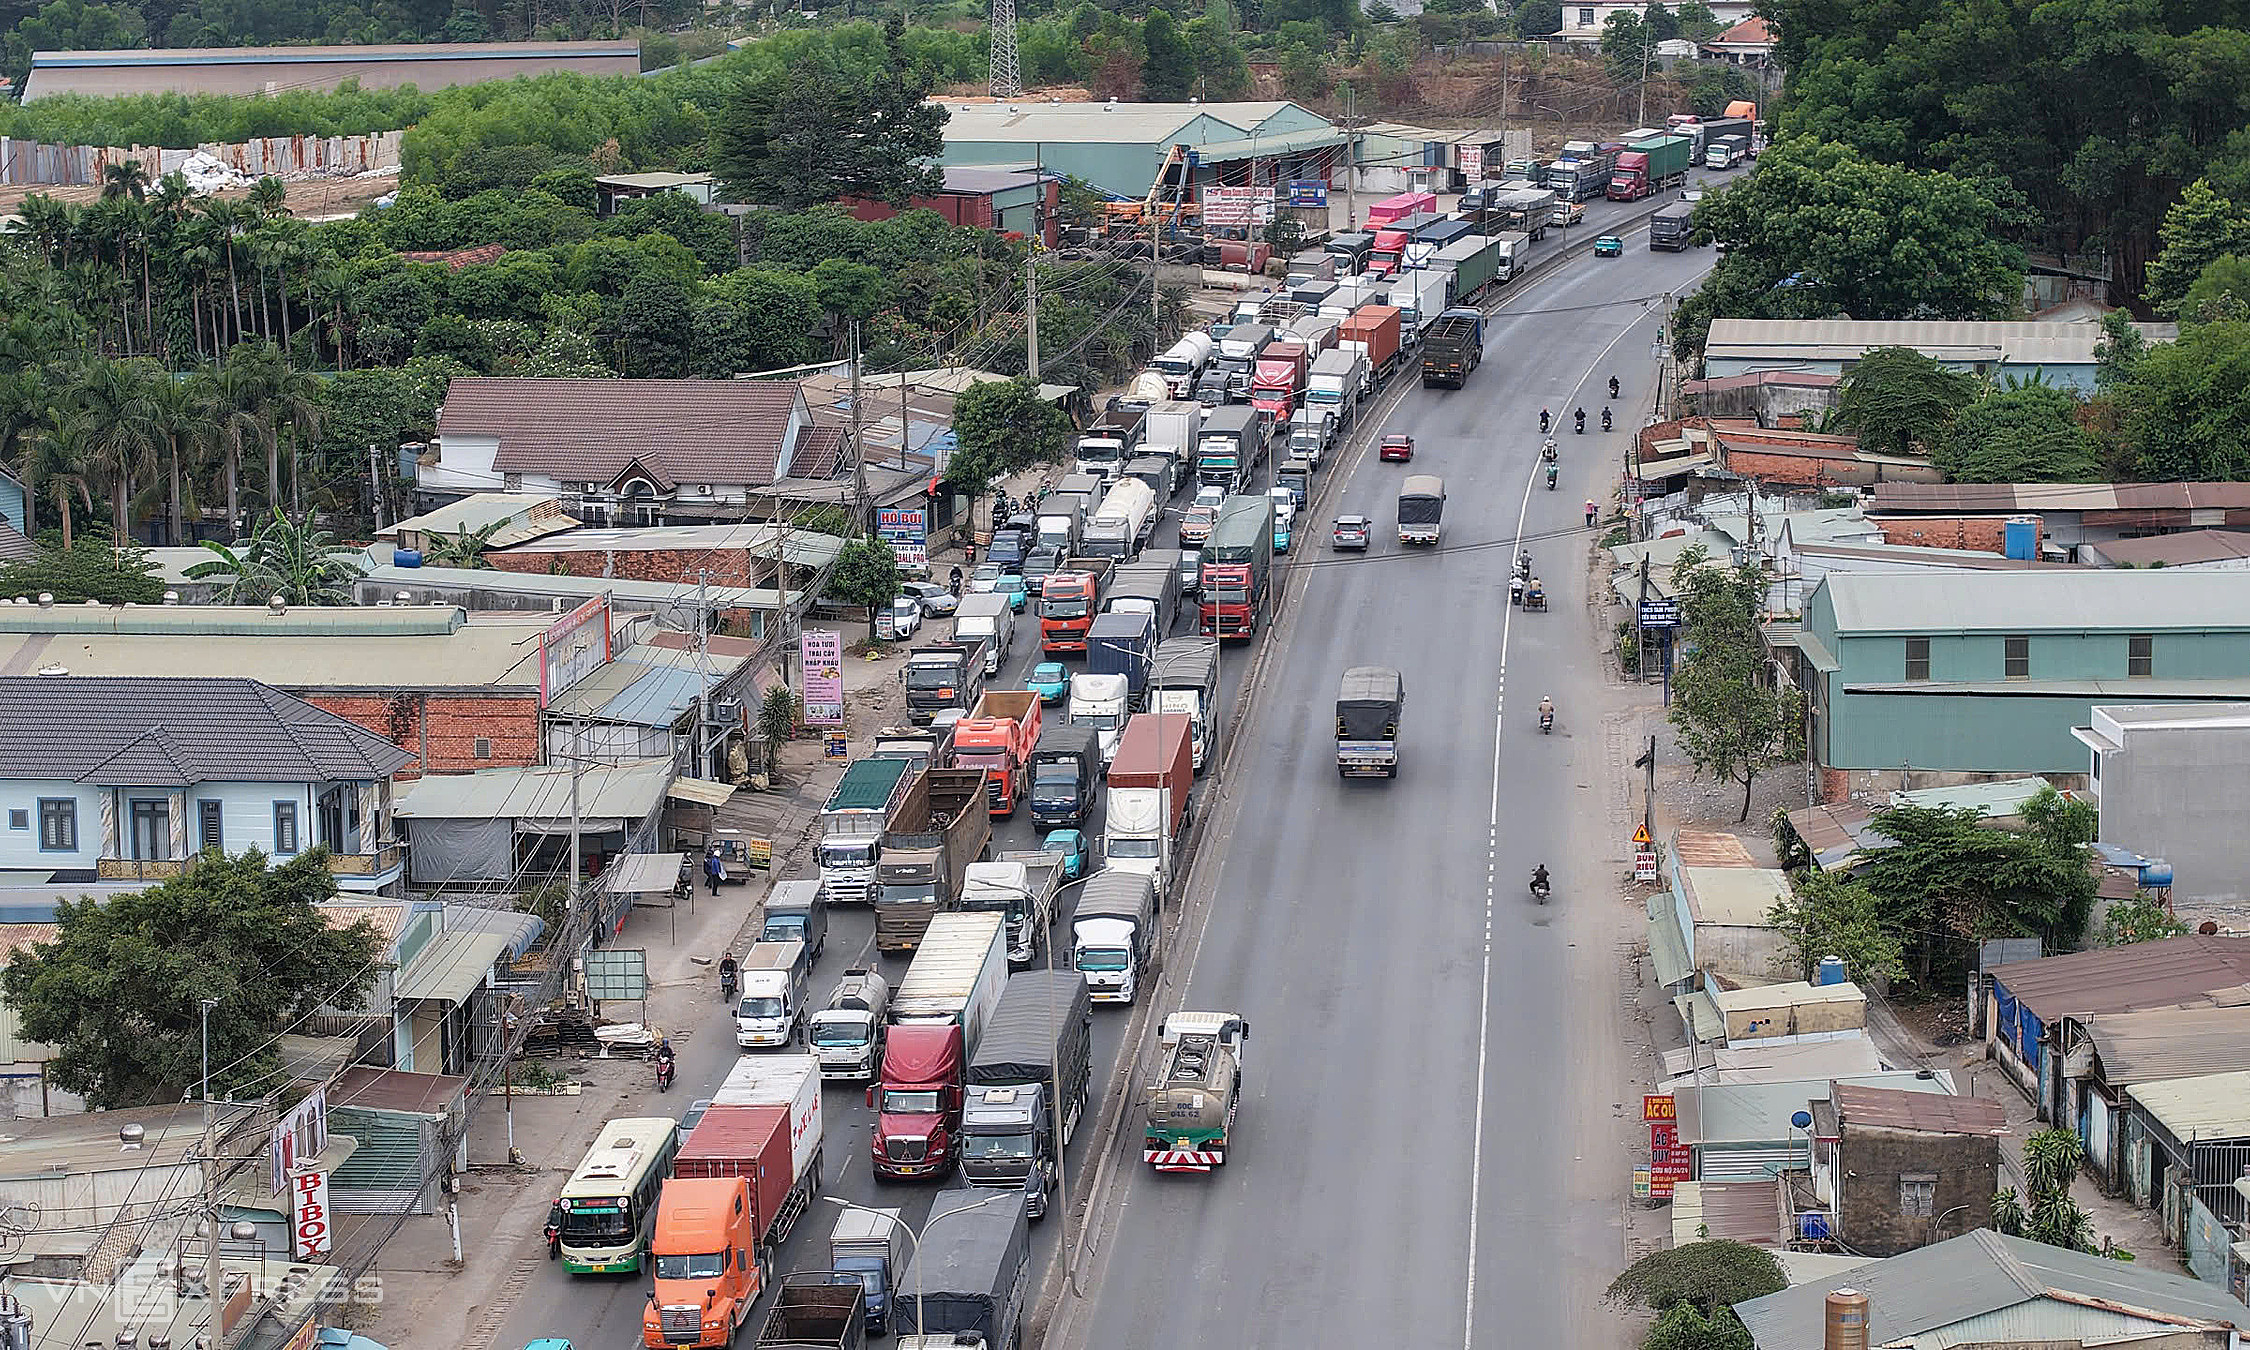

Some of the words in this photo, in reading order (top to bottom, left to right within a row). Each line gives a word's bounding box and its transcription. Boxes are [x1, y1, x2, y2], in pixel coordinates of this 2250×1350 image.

[901, 511, 922, 523] BƠI
[1661, 1104, 1675, 1118] QU
[297, 1173, 327, 1256] BIBOY
